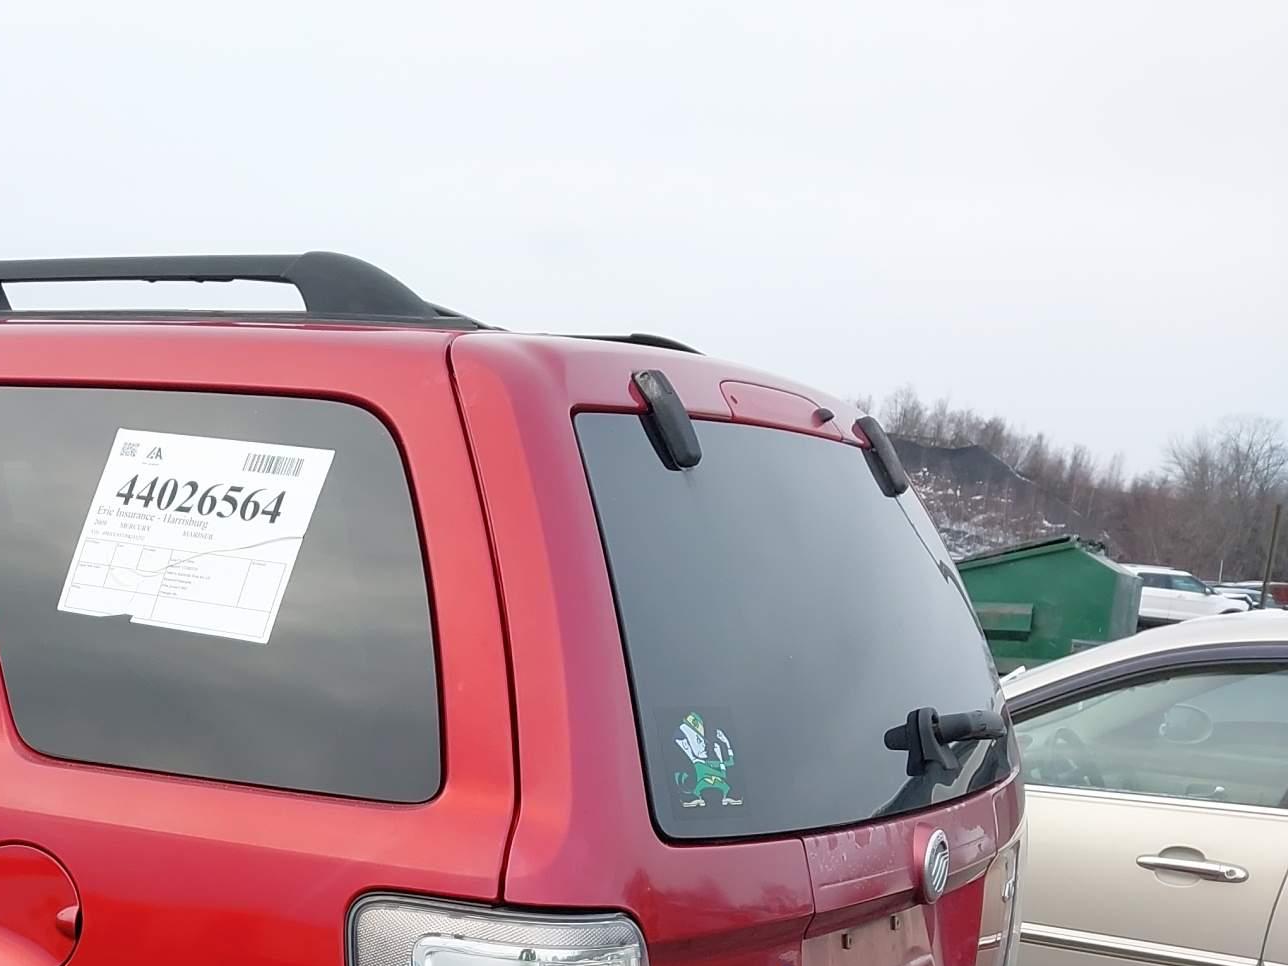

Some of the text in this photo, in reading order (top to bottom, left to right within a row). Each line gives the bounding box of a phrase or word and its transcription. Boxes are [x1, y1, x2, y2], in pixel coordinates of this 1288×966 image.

[97, 505, 115, 517] Erie
[116, 507, 155, 521] Insurance
[163, 512, 209, 529] Harrisburg
[115, 473, 286, 524] 44026564
